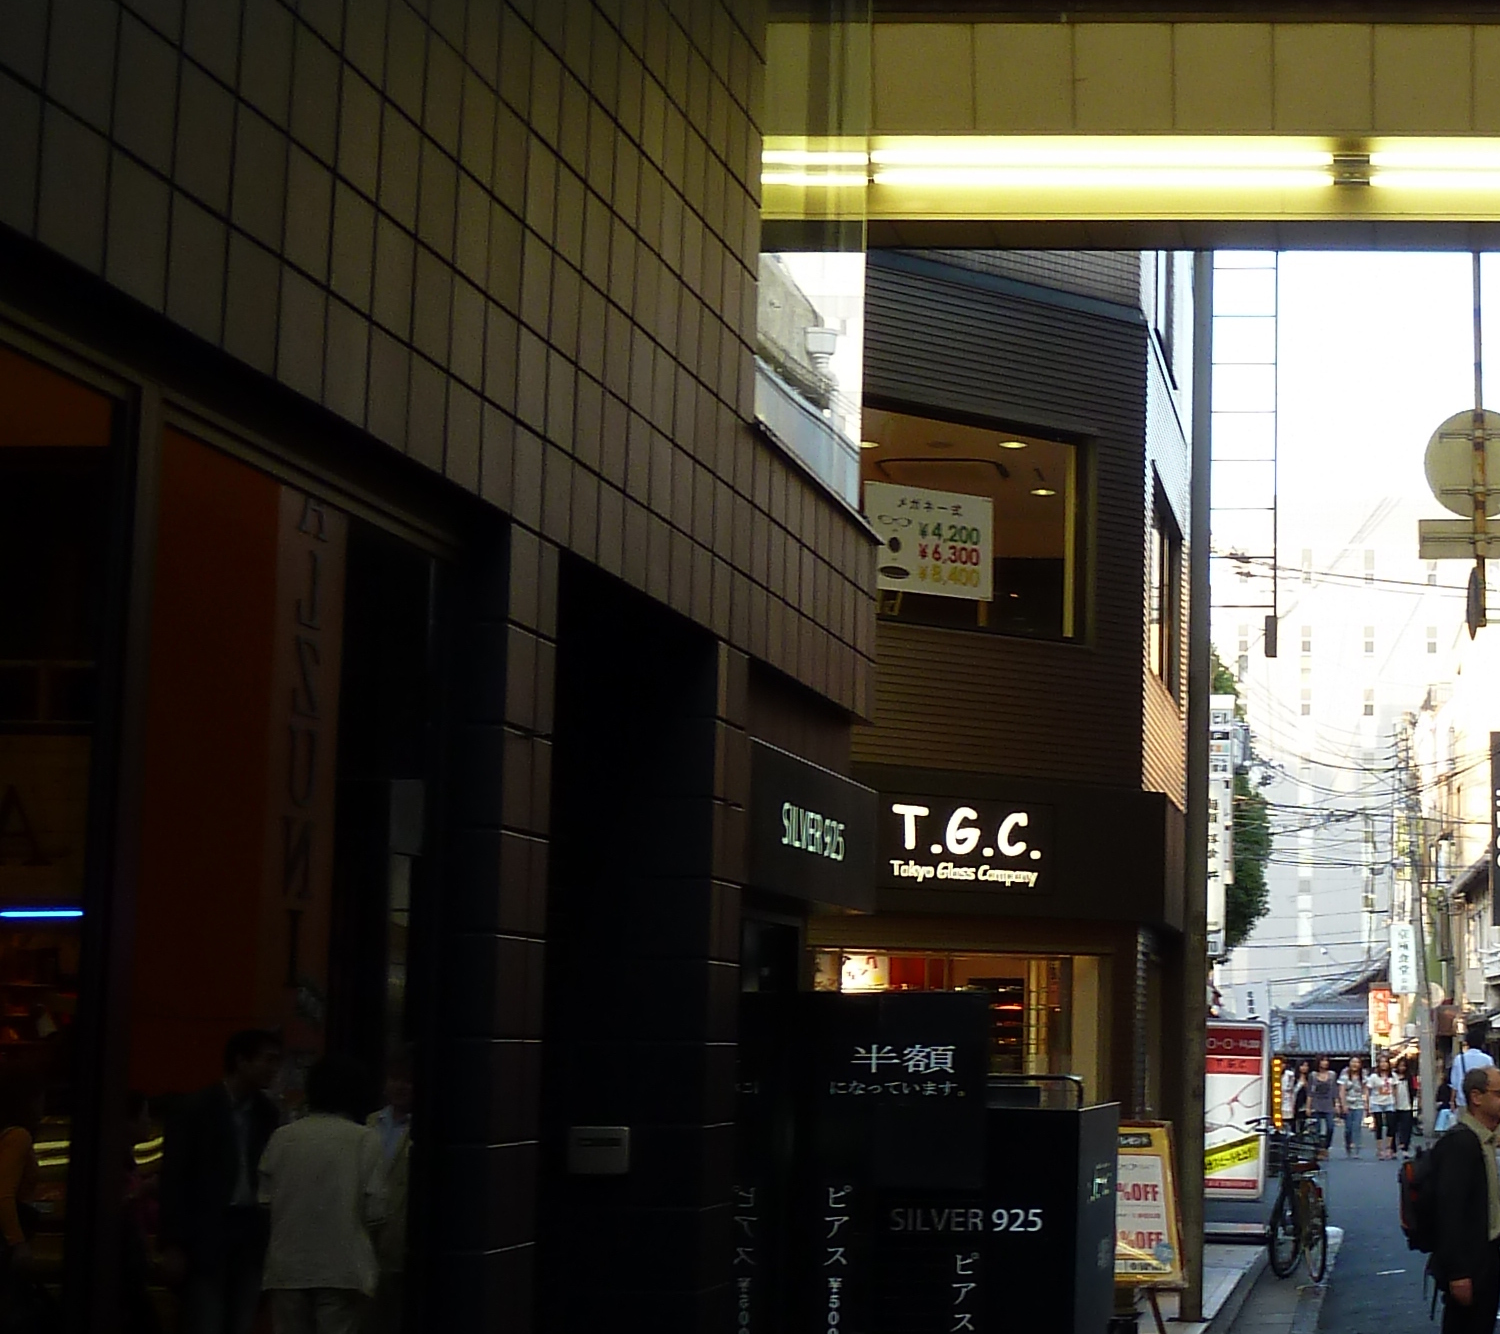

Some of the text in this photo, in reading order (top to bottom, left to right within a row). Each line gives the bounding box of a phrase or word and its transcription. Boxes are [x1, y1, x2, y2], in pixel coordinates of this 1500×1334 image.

[918, 521, 980, 545] ¥4,200
[918, 542, 980, 566] ¥6,300
[782, 802, 845, 861] SILVER 925
[892, 803, 1042, 860] T.G.C.
[889, 860, 1039, 887] Tokyo Glass Company
[850, 1043, 957, 1074] 半額
[829, 1079, 966, 1097] になっています。
[823, 1185, 852, 1266] ピアス
[889, 1208, 1044, 1232] SILVER 925
[950, 1252, 980, 1332] ピアス
